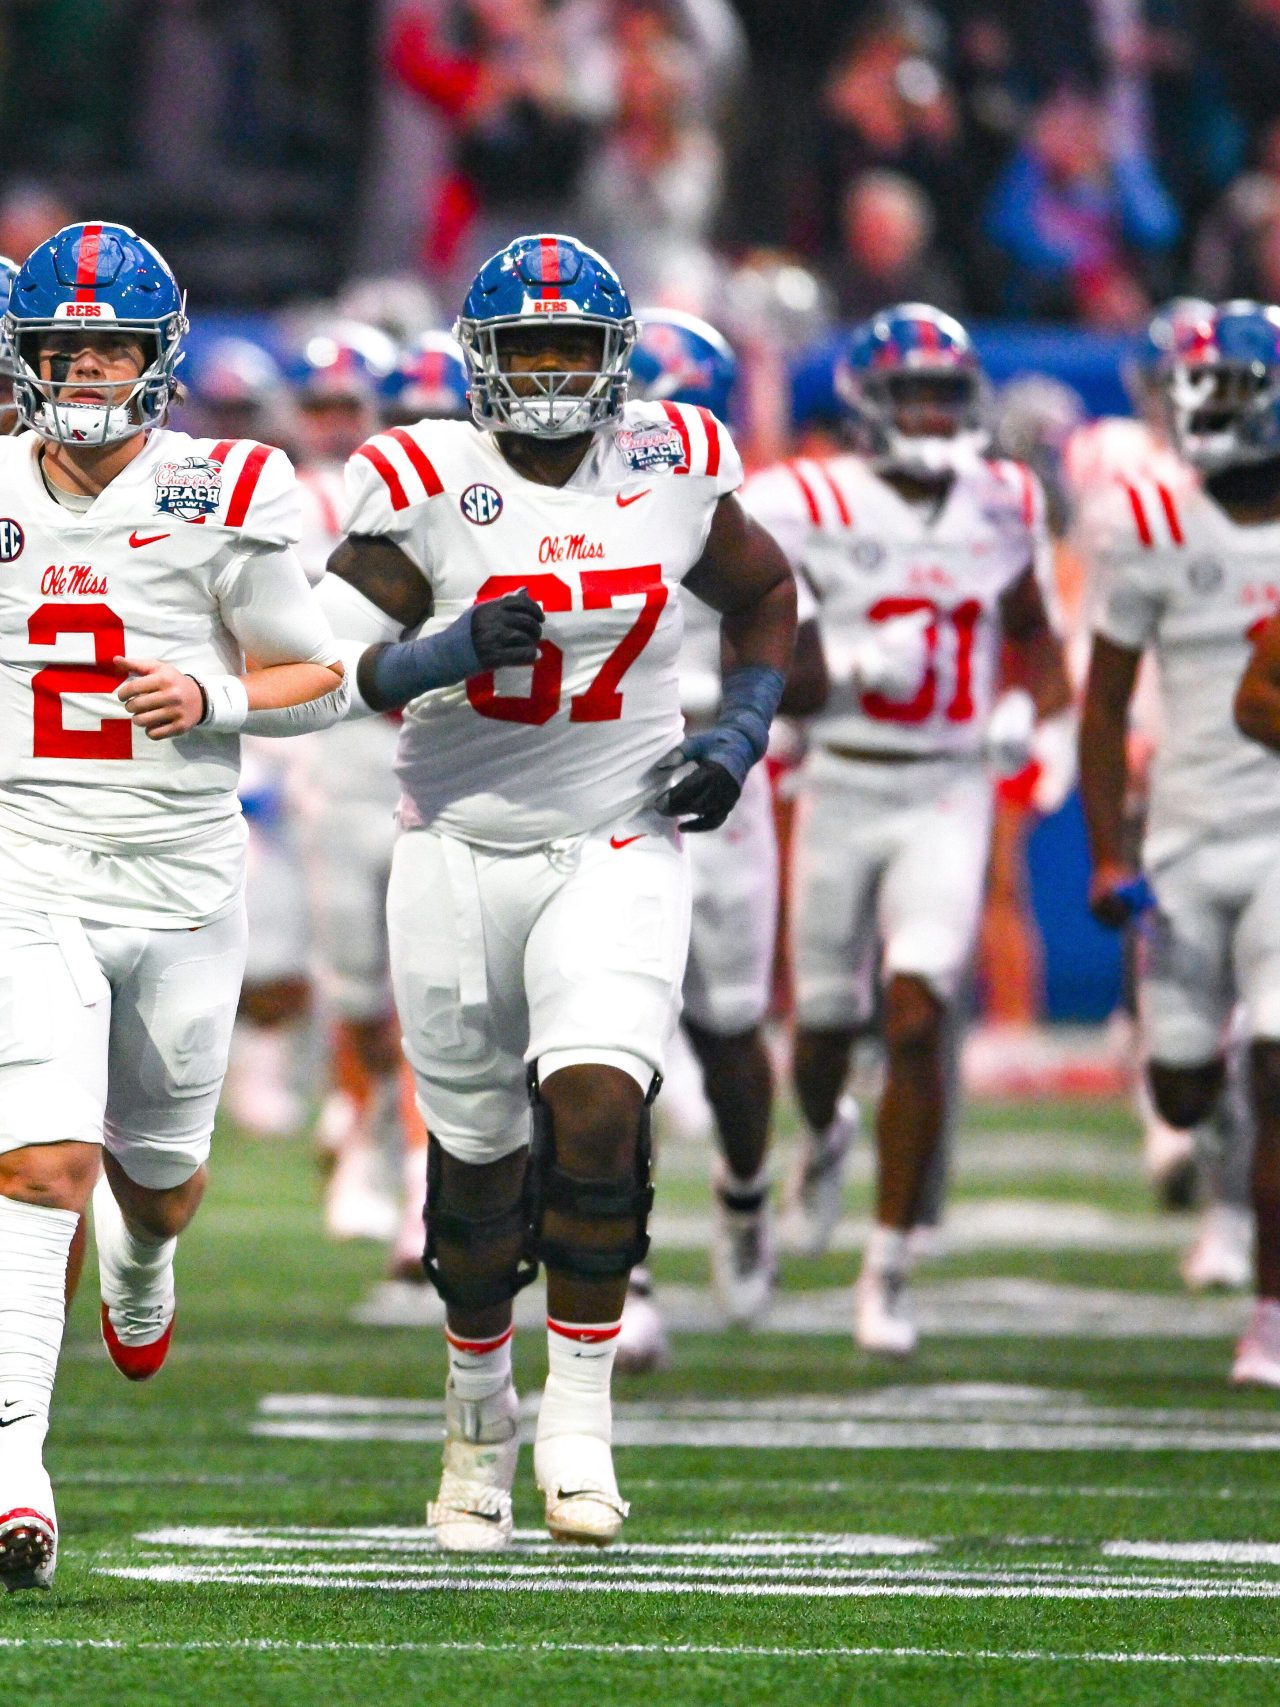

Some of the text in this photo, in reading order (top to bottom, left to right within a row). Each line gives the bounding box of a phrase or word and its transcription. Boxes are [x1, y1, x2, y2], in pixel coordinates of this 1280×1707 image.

[66, 305, 101, 317] REBS
[534, 301, 568, 313] REBS
[623, 440, 683, 465] PEACH
[156, 486, 220, 503] PEACH
[168, 500, 206, 508] BOWL
[463, 486, 500, 522] SEC
[539, 533, 605, 564] Ole Miss
[41, 565, 108, 595] Ole Miss
[465, 564, 668, 726] 67
[27, 603, 133, 760] 2
